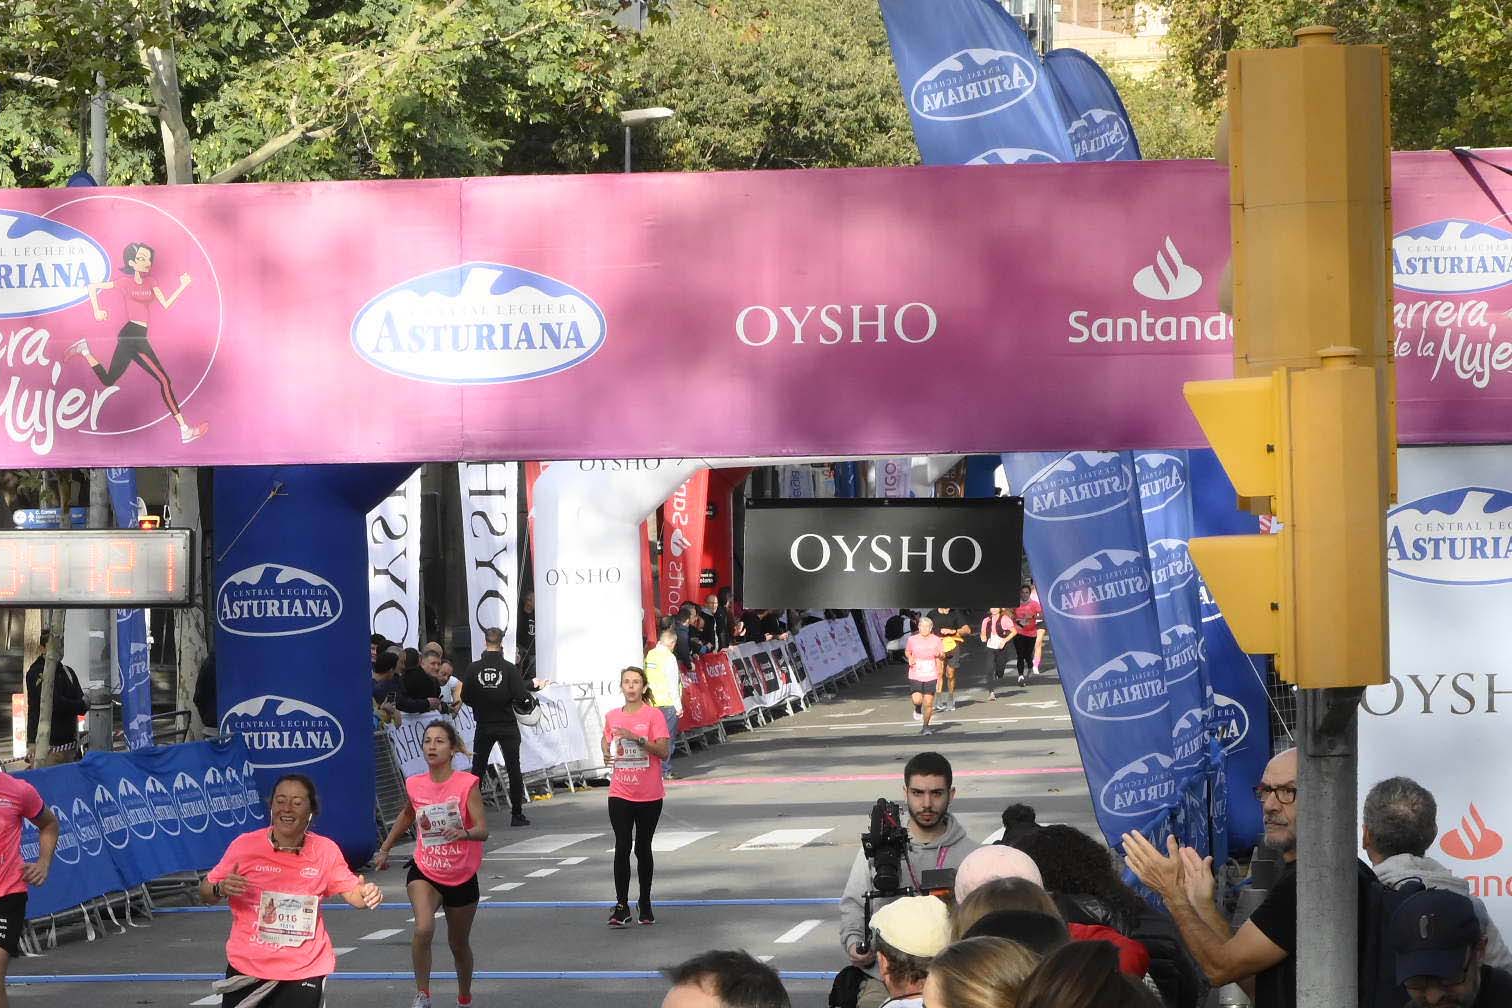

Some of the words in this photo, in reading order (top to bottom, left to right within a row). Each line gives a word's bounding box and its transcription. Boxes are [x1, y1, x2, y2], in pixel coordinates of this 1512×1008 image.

[14, 246, 88, 257] LECHERA
[496, 302, 578, 316] LECHERA
[372, 309, 587, 353] ASTURIANA
[735, 302, 938, 347] OYSHO
[1068, 310, 1235, 343] Santand
[1417, 331, 1435, 357] la
[1414, 522, 1482, 534] CENTRAL
[790, 533, 983, 574] OYSHO
[545, 566, 621, 587] OYSHO
[233, 589, 276, 598] CENTRAL
[280, 588, 329, 597] LECHERA
[220, 593, 333, 620] ASTURIANA
[484, 672, 497, 682] BP
[234, 720, 277, 730] CENTRAL
[280, 720, 330, 729] LECHERA
[278, 913, 297, 924] 016
